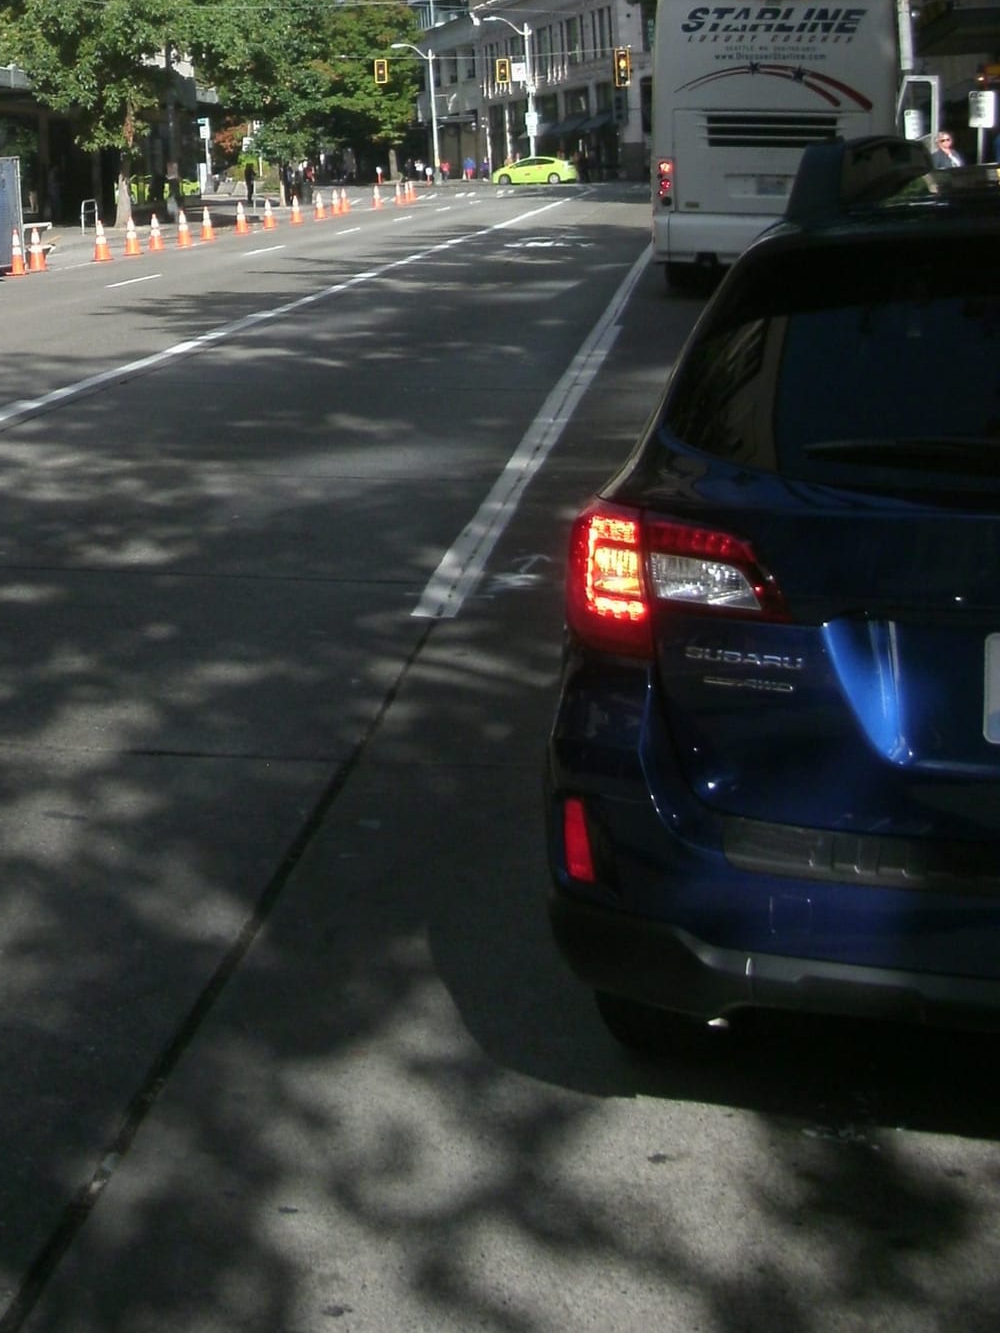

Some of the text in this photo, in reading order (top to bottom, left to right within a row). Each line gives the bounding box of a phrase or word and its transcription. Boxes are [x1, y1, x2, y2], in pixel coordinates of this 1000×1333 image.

[680, 7, 868, 34] STARLINE
[687, 34, 854, 44] LUXURY COACHES
[714, 52, 826, 61] www.DiscoverStarline.com
[685, 646, 804, 670] SUBARU
